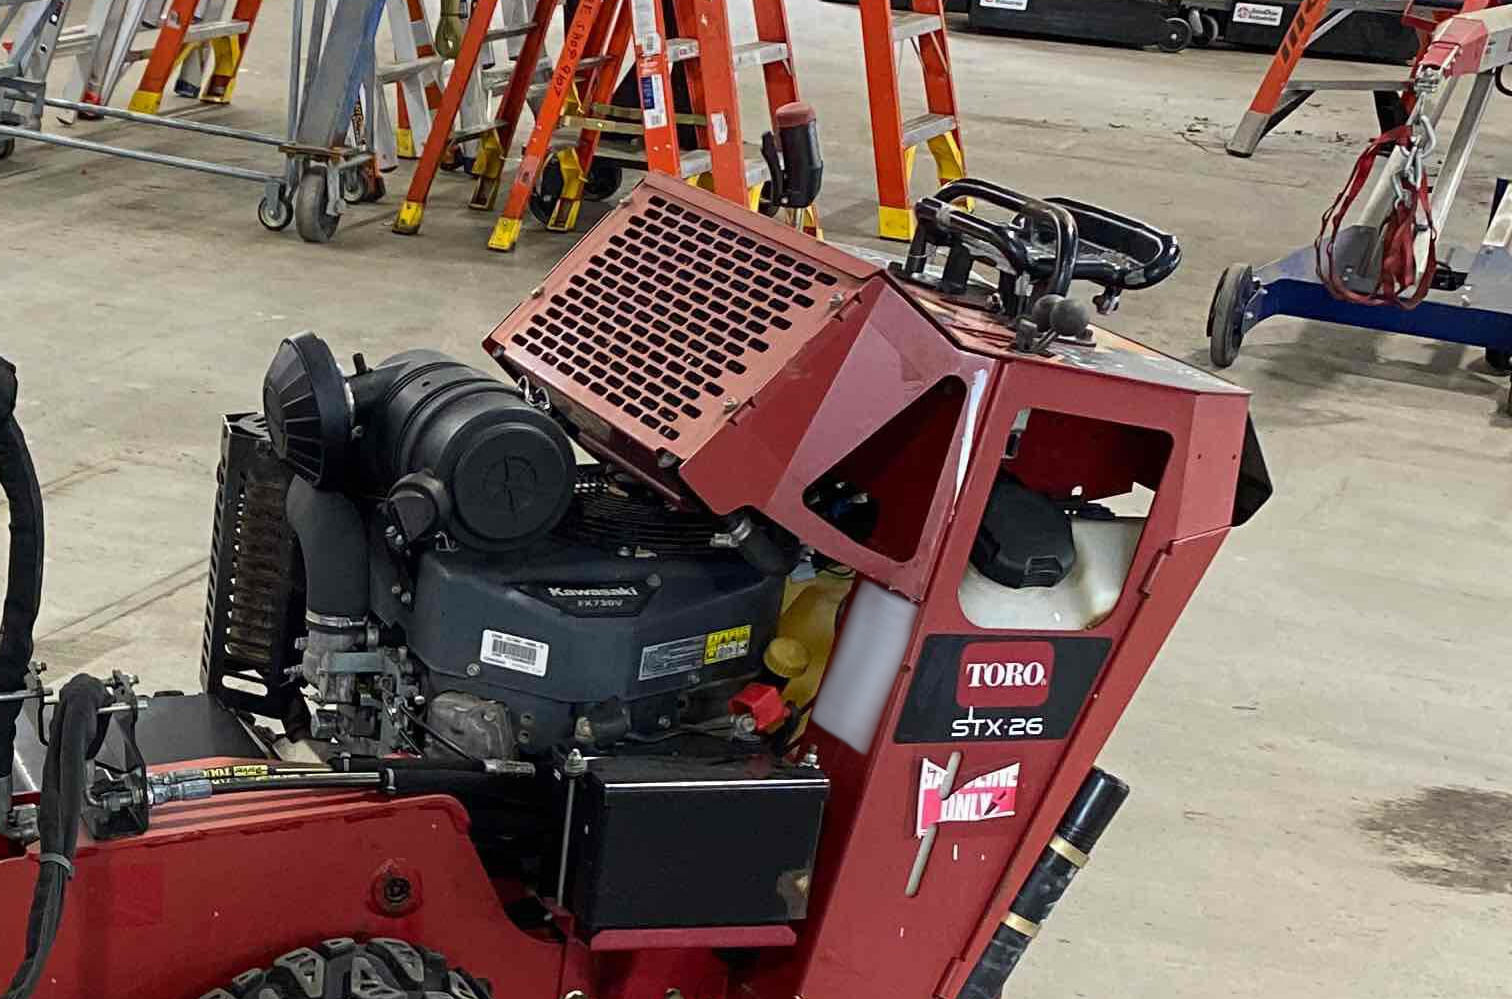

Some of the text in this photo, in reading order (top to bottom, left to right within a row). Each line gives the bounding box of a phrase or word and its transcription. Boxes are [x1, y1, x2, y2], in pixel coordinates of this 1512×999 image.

[548, 586, 638, 596] Kawasaki
[966, 662, 1045, 687] TORO
[941, 792, 995, 819] ONLY
